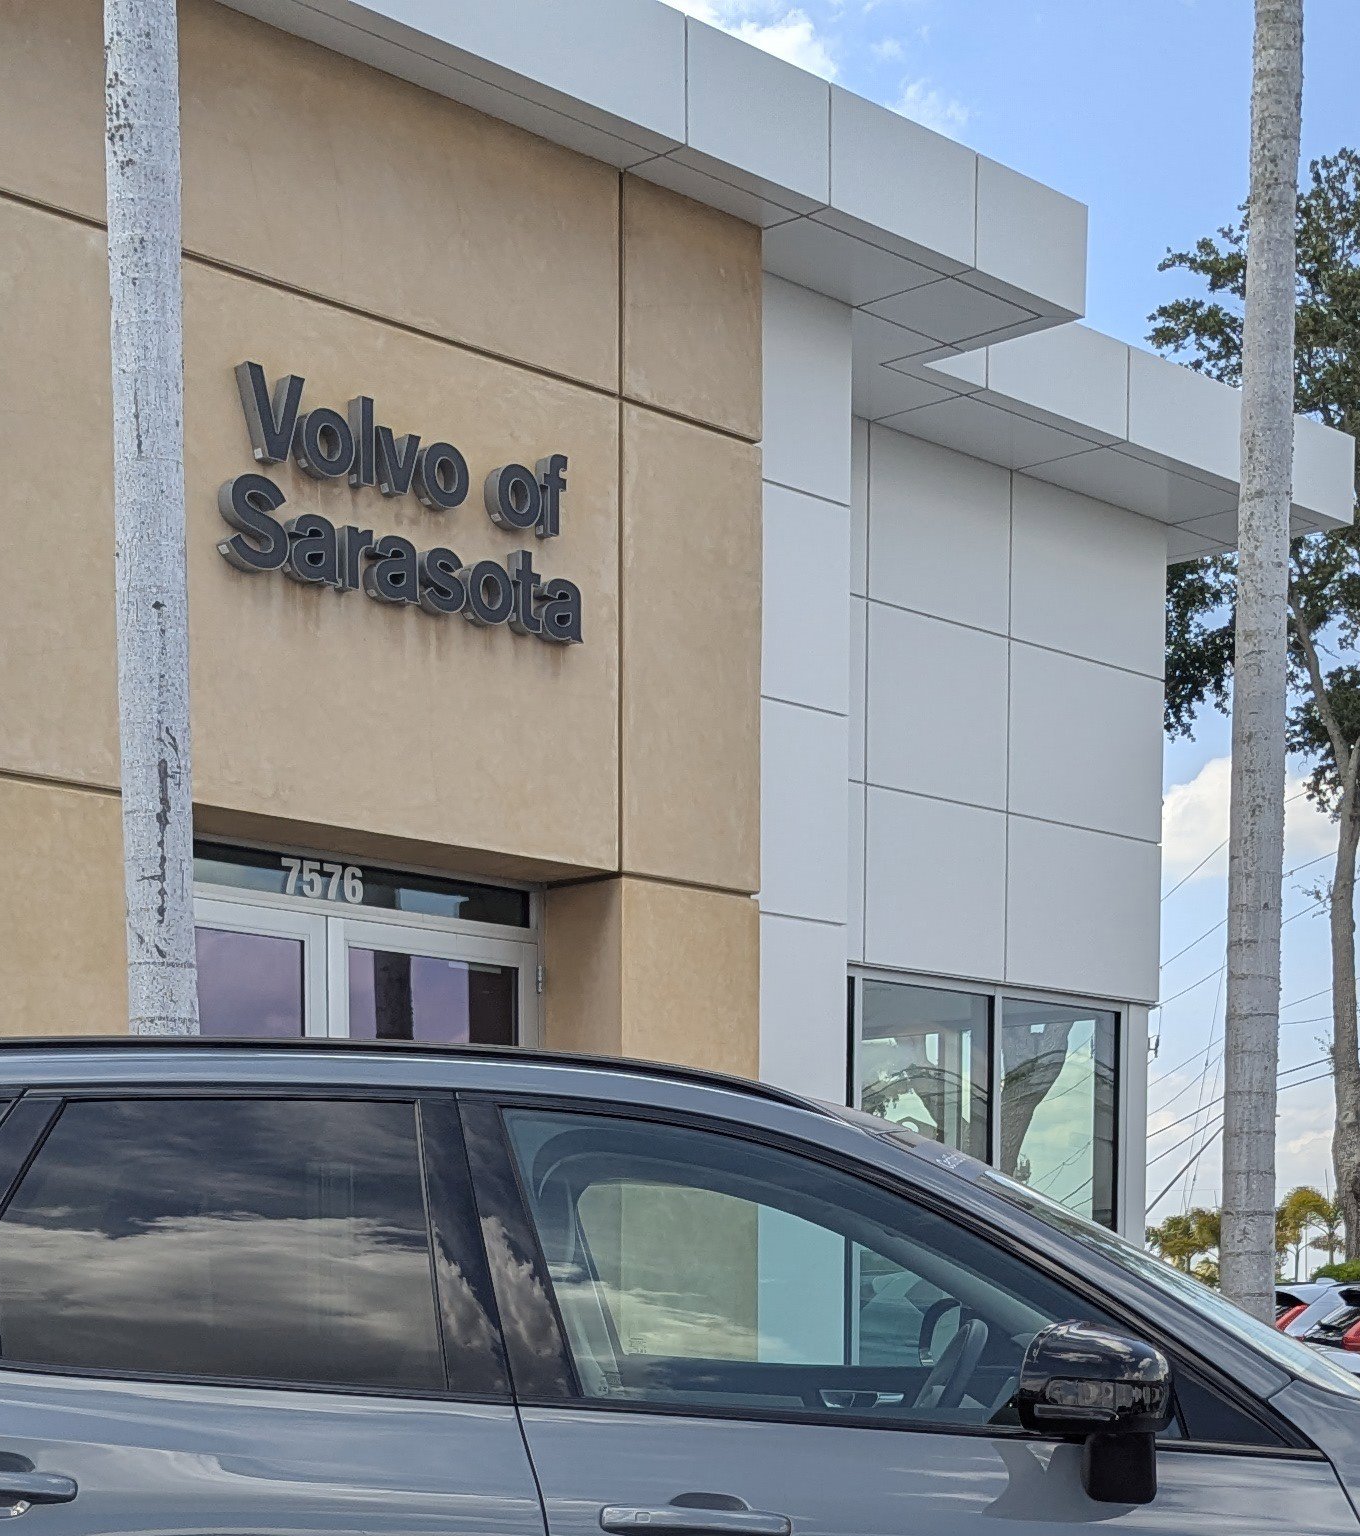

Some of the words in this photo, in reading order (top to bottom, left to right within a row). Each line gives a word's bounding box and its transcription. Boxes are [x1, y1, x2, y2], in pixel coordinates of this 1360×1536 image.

[235, 361, 469, 510] Volvo
[484, 454, 568, 538] of
[217, 473, 583, 645] Sarasota
[281, 857, 364, 903] 7576
